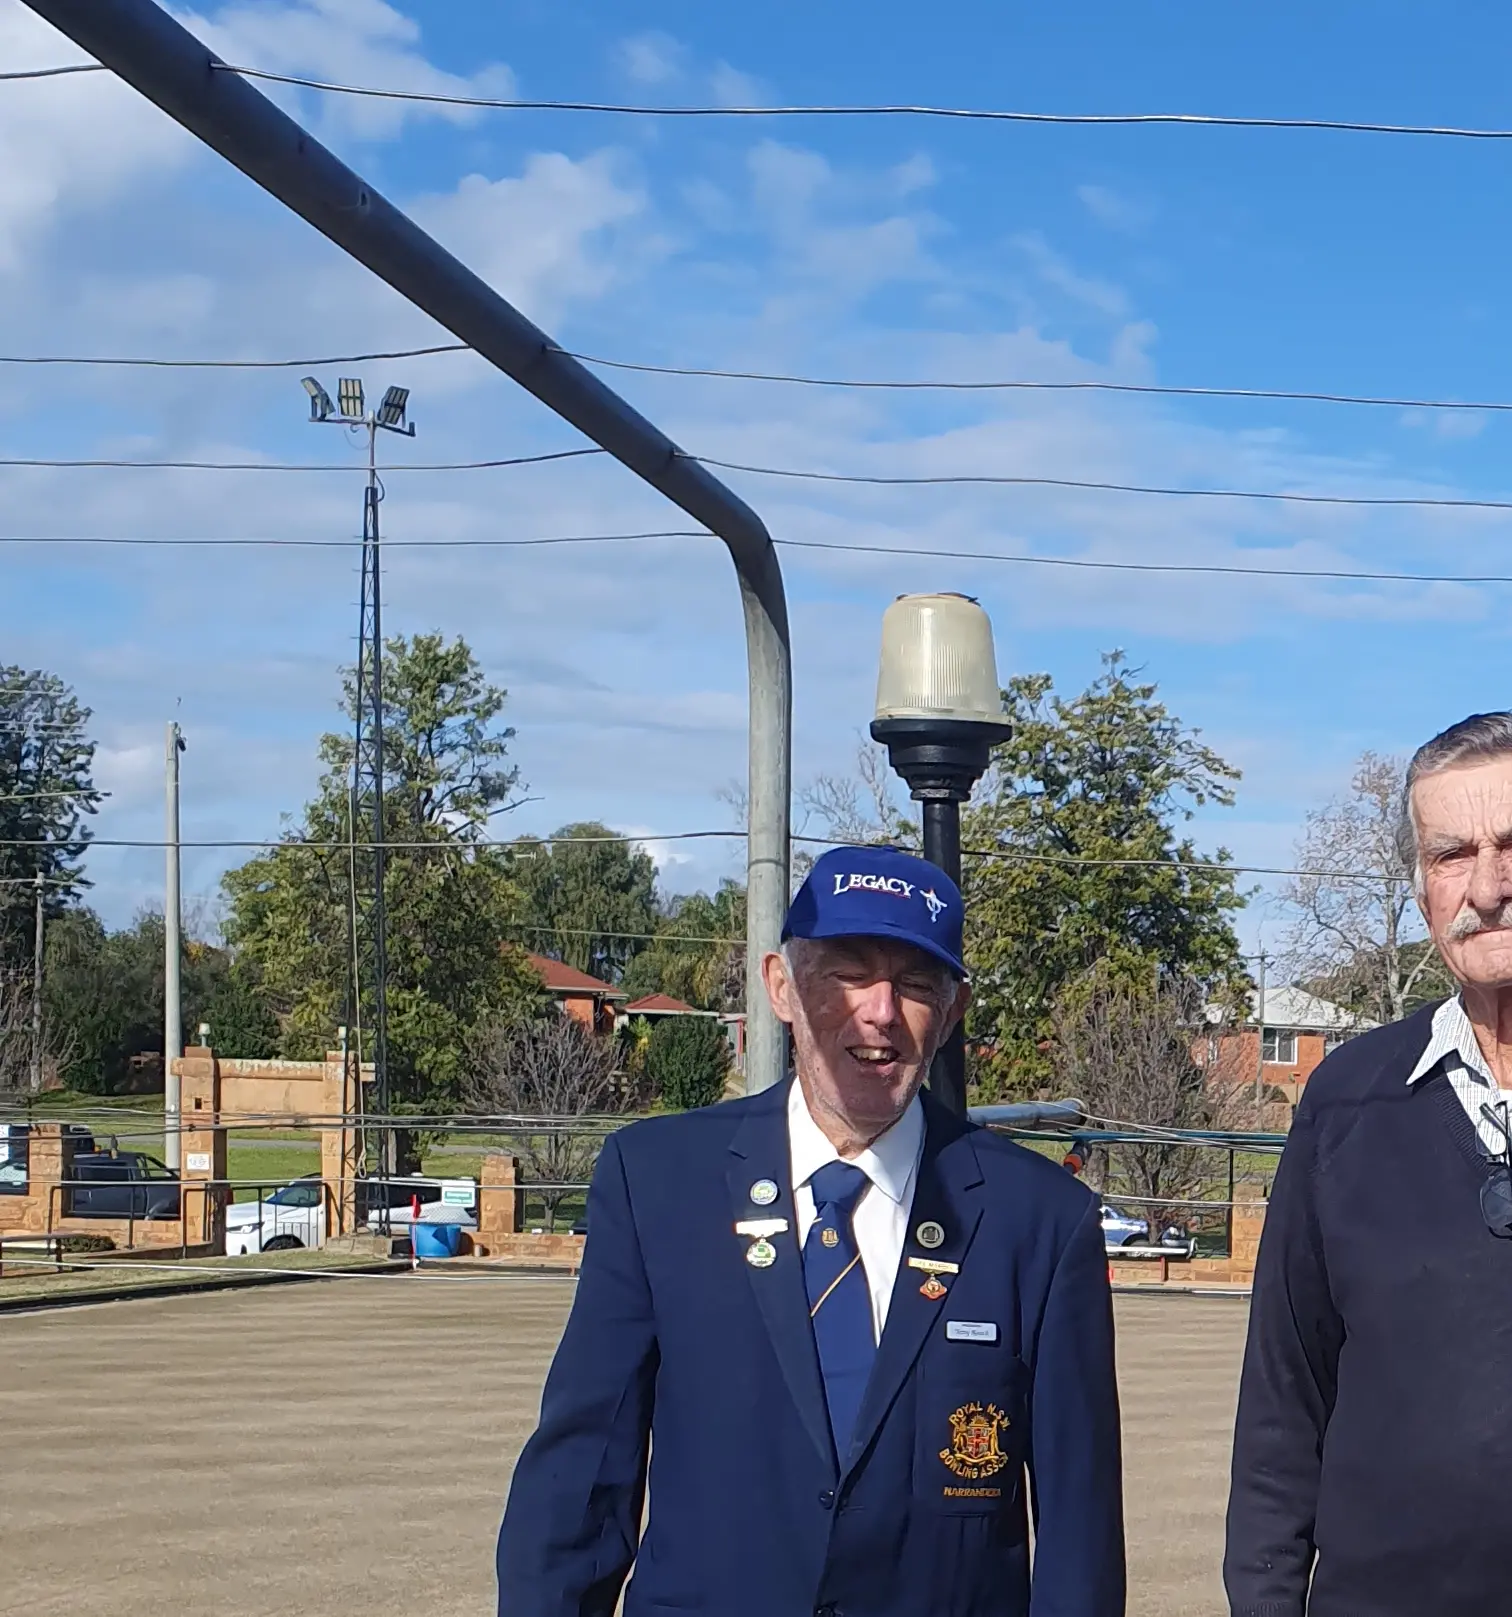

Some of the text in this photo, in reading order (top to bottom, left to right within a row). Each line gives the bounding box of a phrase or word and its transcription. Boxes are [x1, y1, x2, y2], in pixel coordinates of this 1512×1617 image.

[833, 873, 915, 899] LEGACY
[949, 1400, 983, 1427] ROYAL
[939, 1448, 979, 1479] BOWLING
